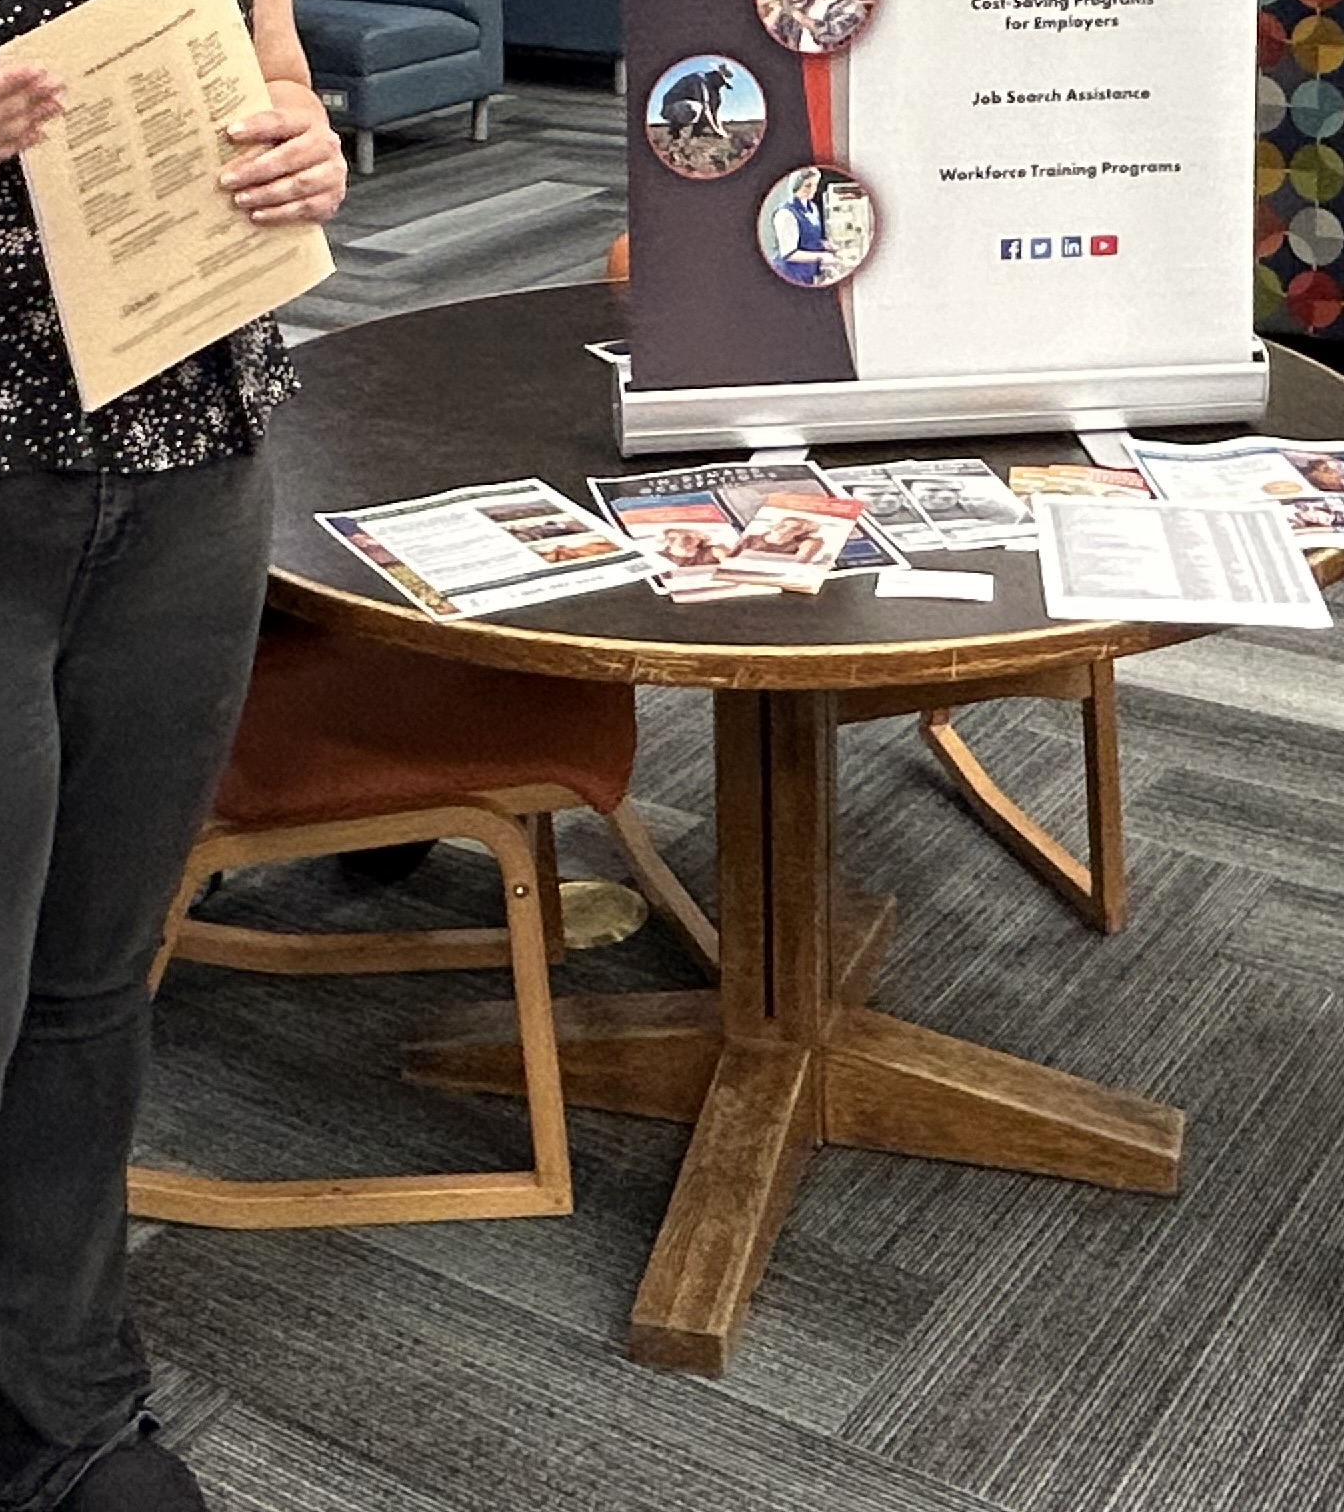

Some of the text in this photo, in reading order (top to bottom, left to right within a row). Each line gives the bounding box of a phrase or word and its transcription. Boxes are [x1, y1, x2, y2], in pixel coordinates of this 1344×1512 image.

[1005, 14, 1120, 34] for Employers
[972, 88, 1151, 107] Job Search Assistance
[938, 161, 1182, 182] Workforce Training Programs
